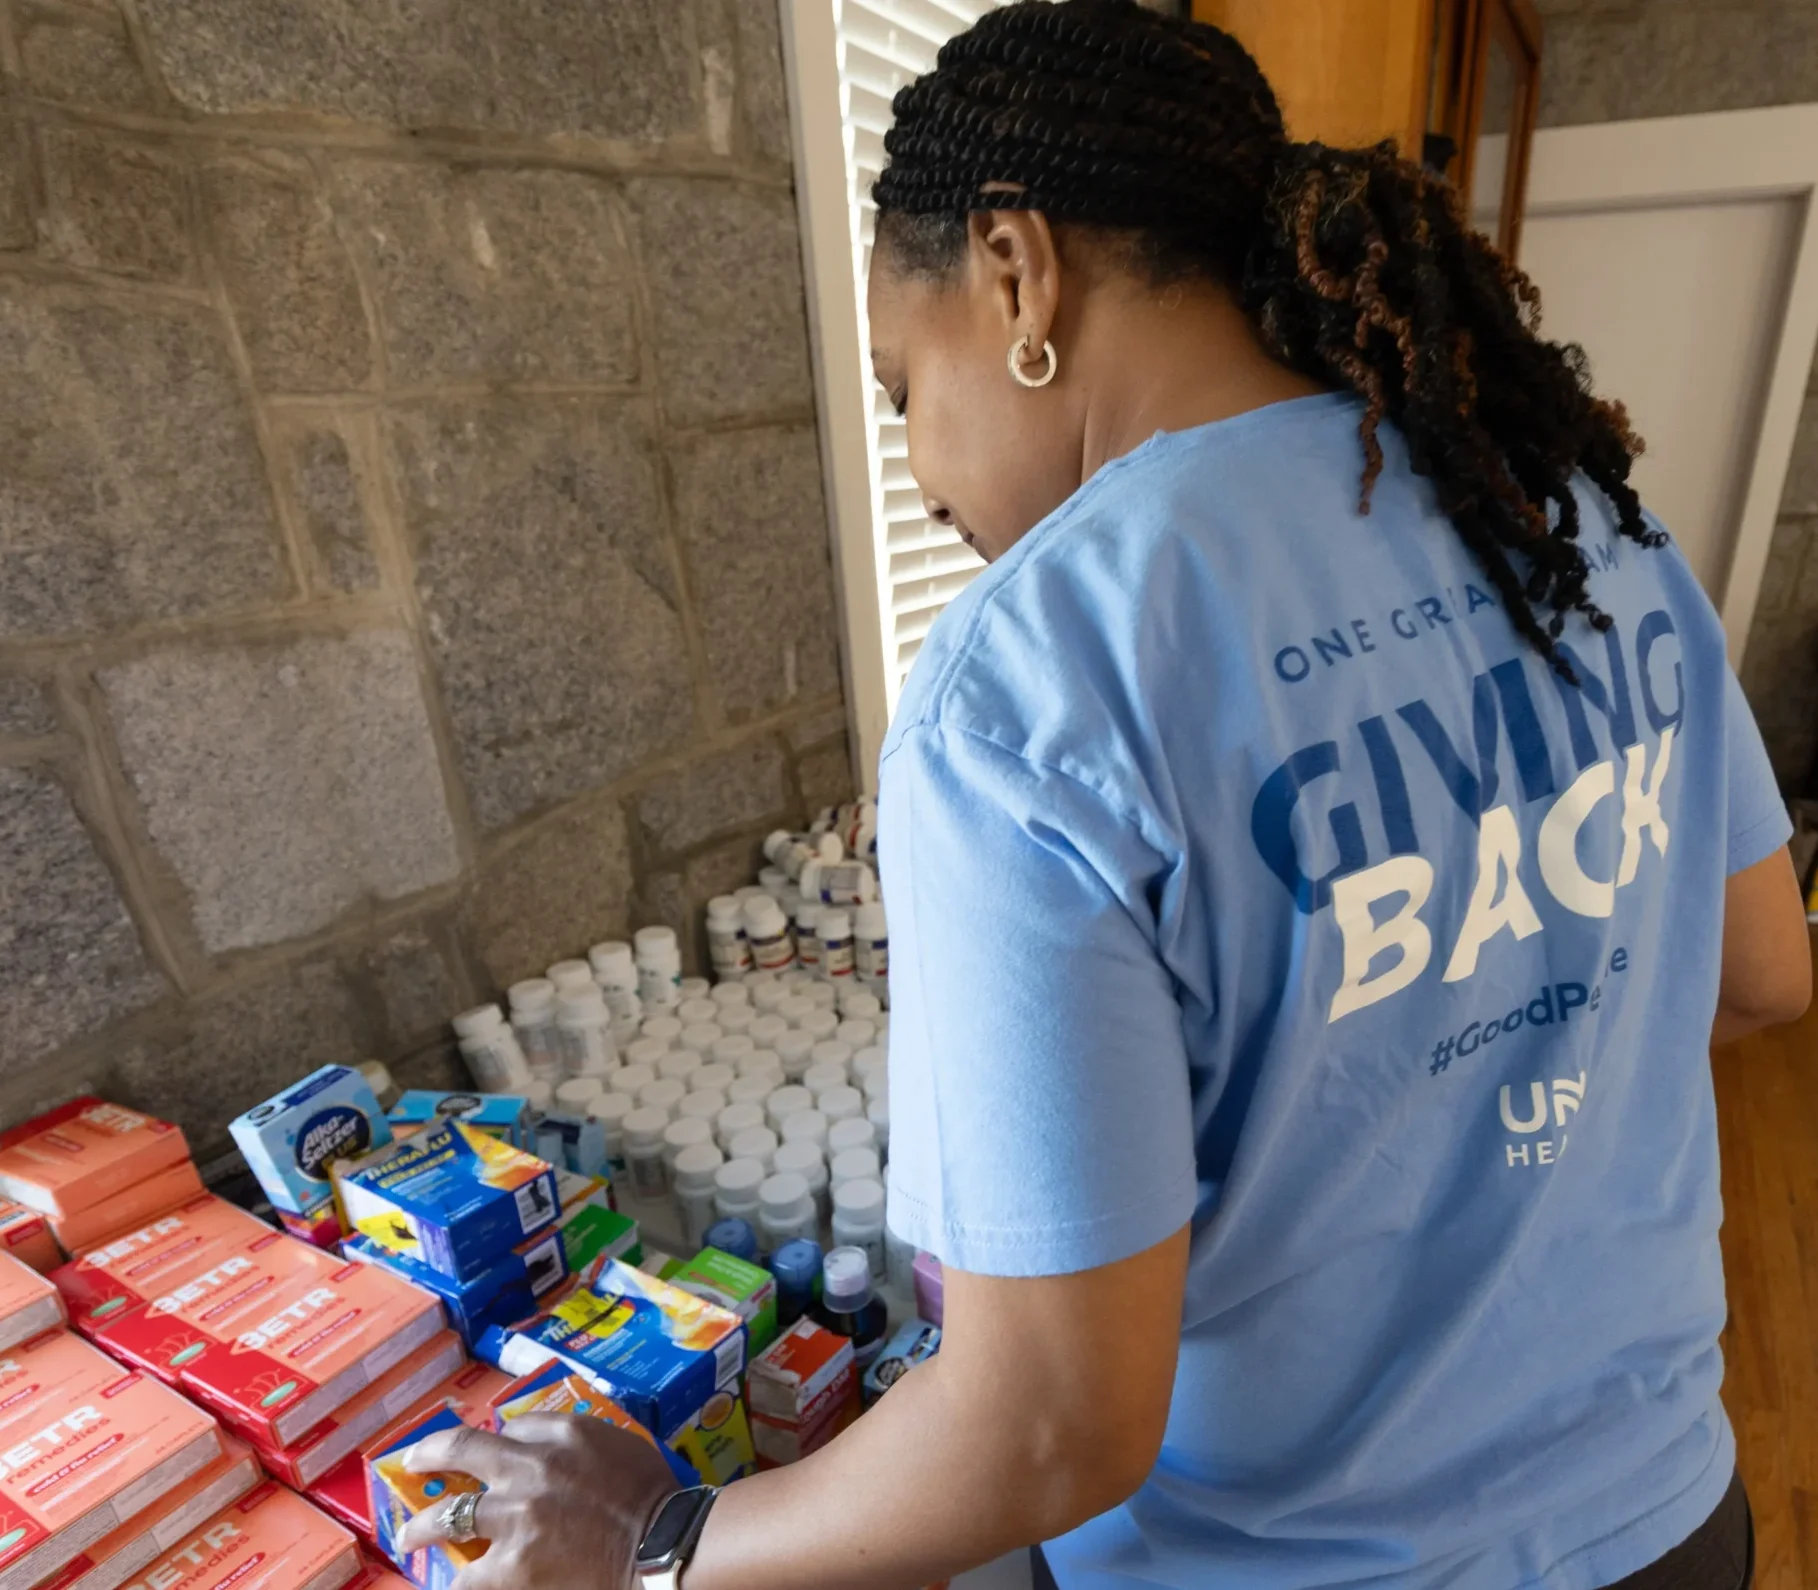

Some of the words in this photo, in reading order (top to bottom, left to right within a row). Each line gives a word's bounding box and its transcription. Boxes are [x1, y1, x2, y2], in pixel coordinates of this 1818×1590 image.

[1274, 619, 1376, 683] ONE
[1252, 610, 1685, 915] GIVING
[1328, 727, 1671, 1024] BACK
[301, 1116, 358, 1170] Seltzer
[7, 1418, 111, 1485] remedies
[32, 1473, 59, 1494] cold
[85, 1435, 116, 1458] relief
[127, 1521, 242, 1590] ETR
[173, 1535, 250, 1590] medies
